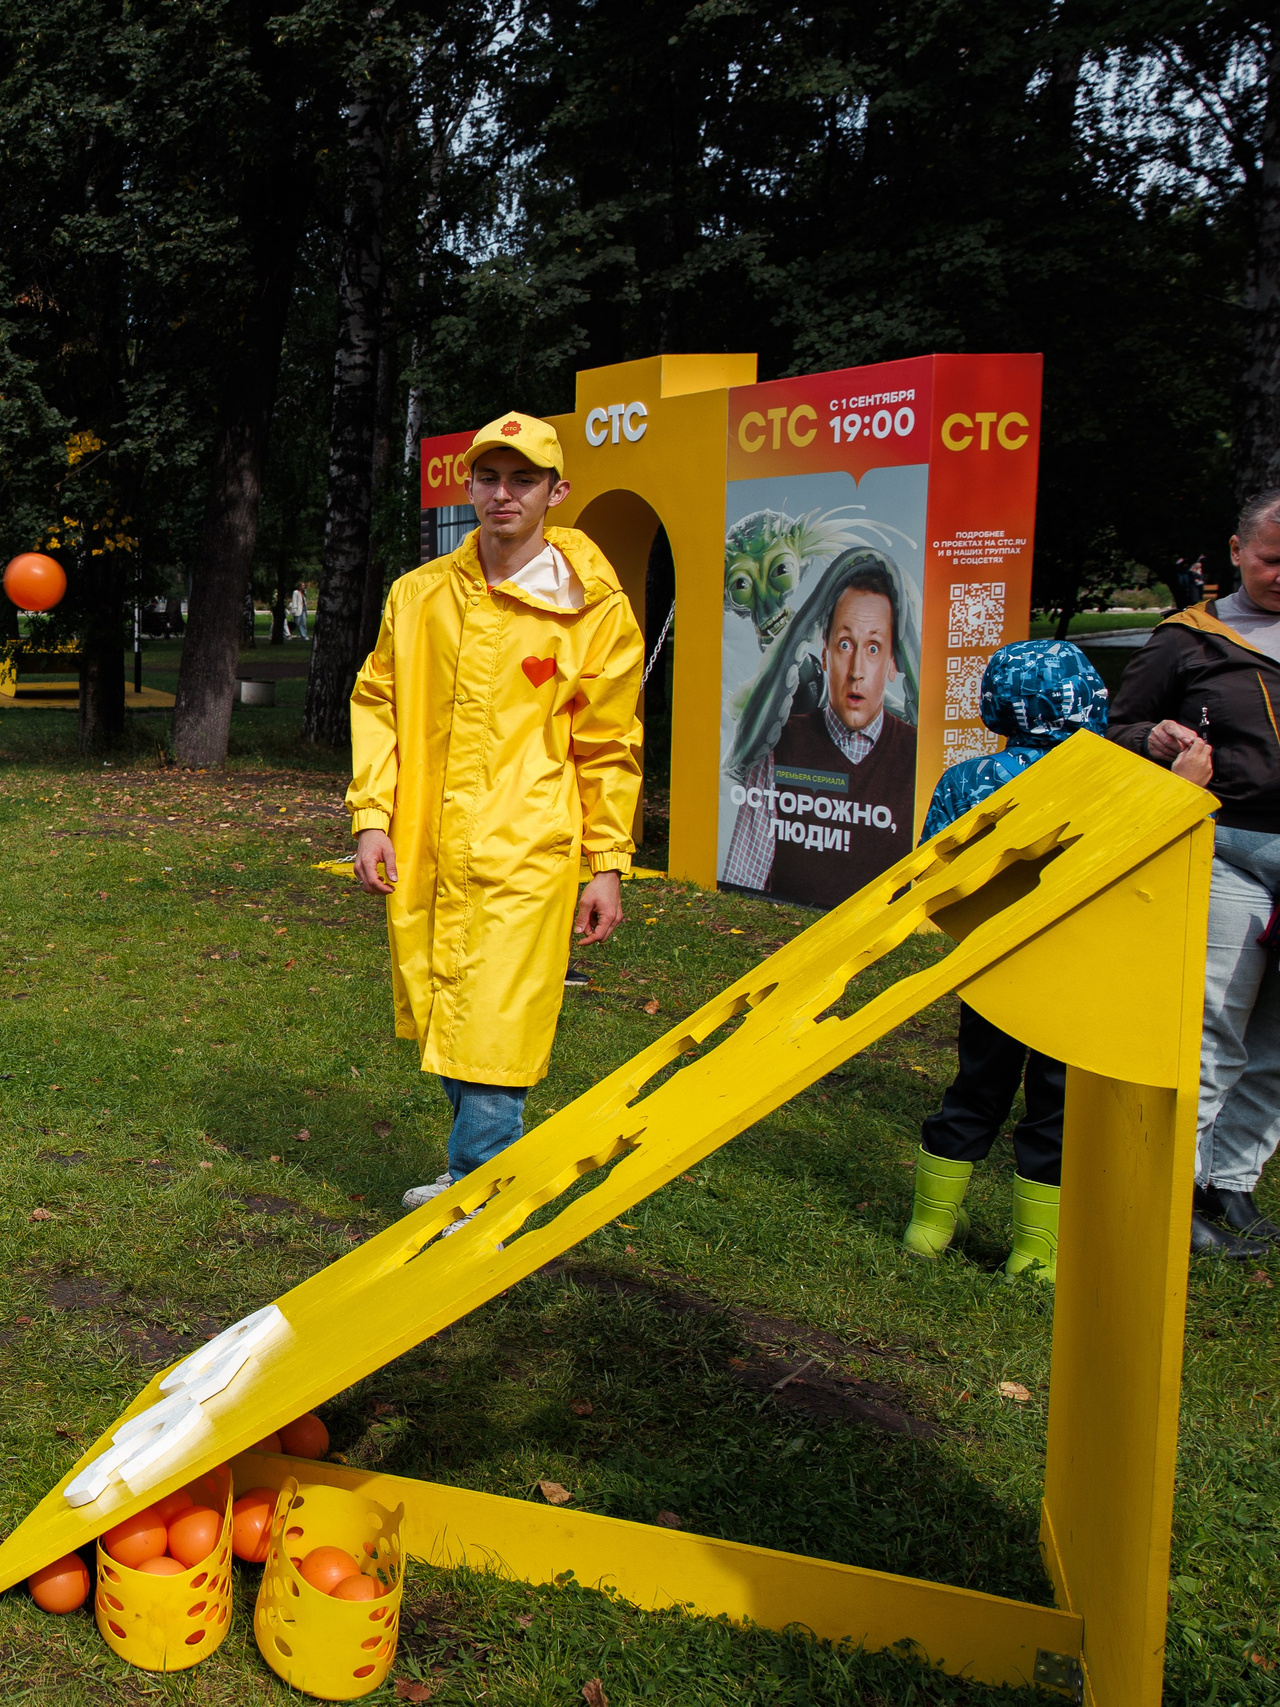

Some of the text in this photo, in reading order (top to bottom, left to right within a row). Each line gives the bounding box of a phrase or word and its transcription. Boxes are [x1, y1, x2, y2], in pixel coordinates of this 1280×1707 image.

[829, 388, 915, 411] С 1 СЕНТЯБРЯ
[585, 401, 648, 447] СТС
[737, 404, 818, 453] СТС
[828, 406, 915, 443] 19:00
[940, 411, 1029, 451] СТС
[427, 452, 470, 488] СТС
[941, 539, 983, 548] ПРОЕКТАХ
[955, 530, 1005, 539] ПОДРОБНЕЕ
[945, 549, 952, 557] В
[953, 548, 983, 556] НАШИХ
[984, 547, 1021, 555] ГРУППАХ
[960, 556, 1004, 565] СОЦСЕТЯХ
[775, 770, 846, 787] ПРЕМЬЕРА СЕРИАЛА
[730, 784, 897, 834] ОСТОРОЖНО,
[768, 818, 851, 852] ЛЮДИ!
